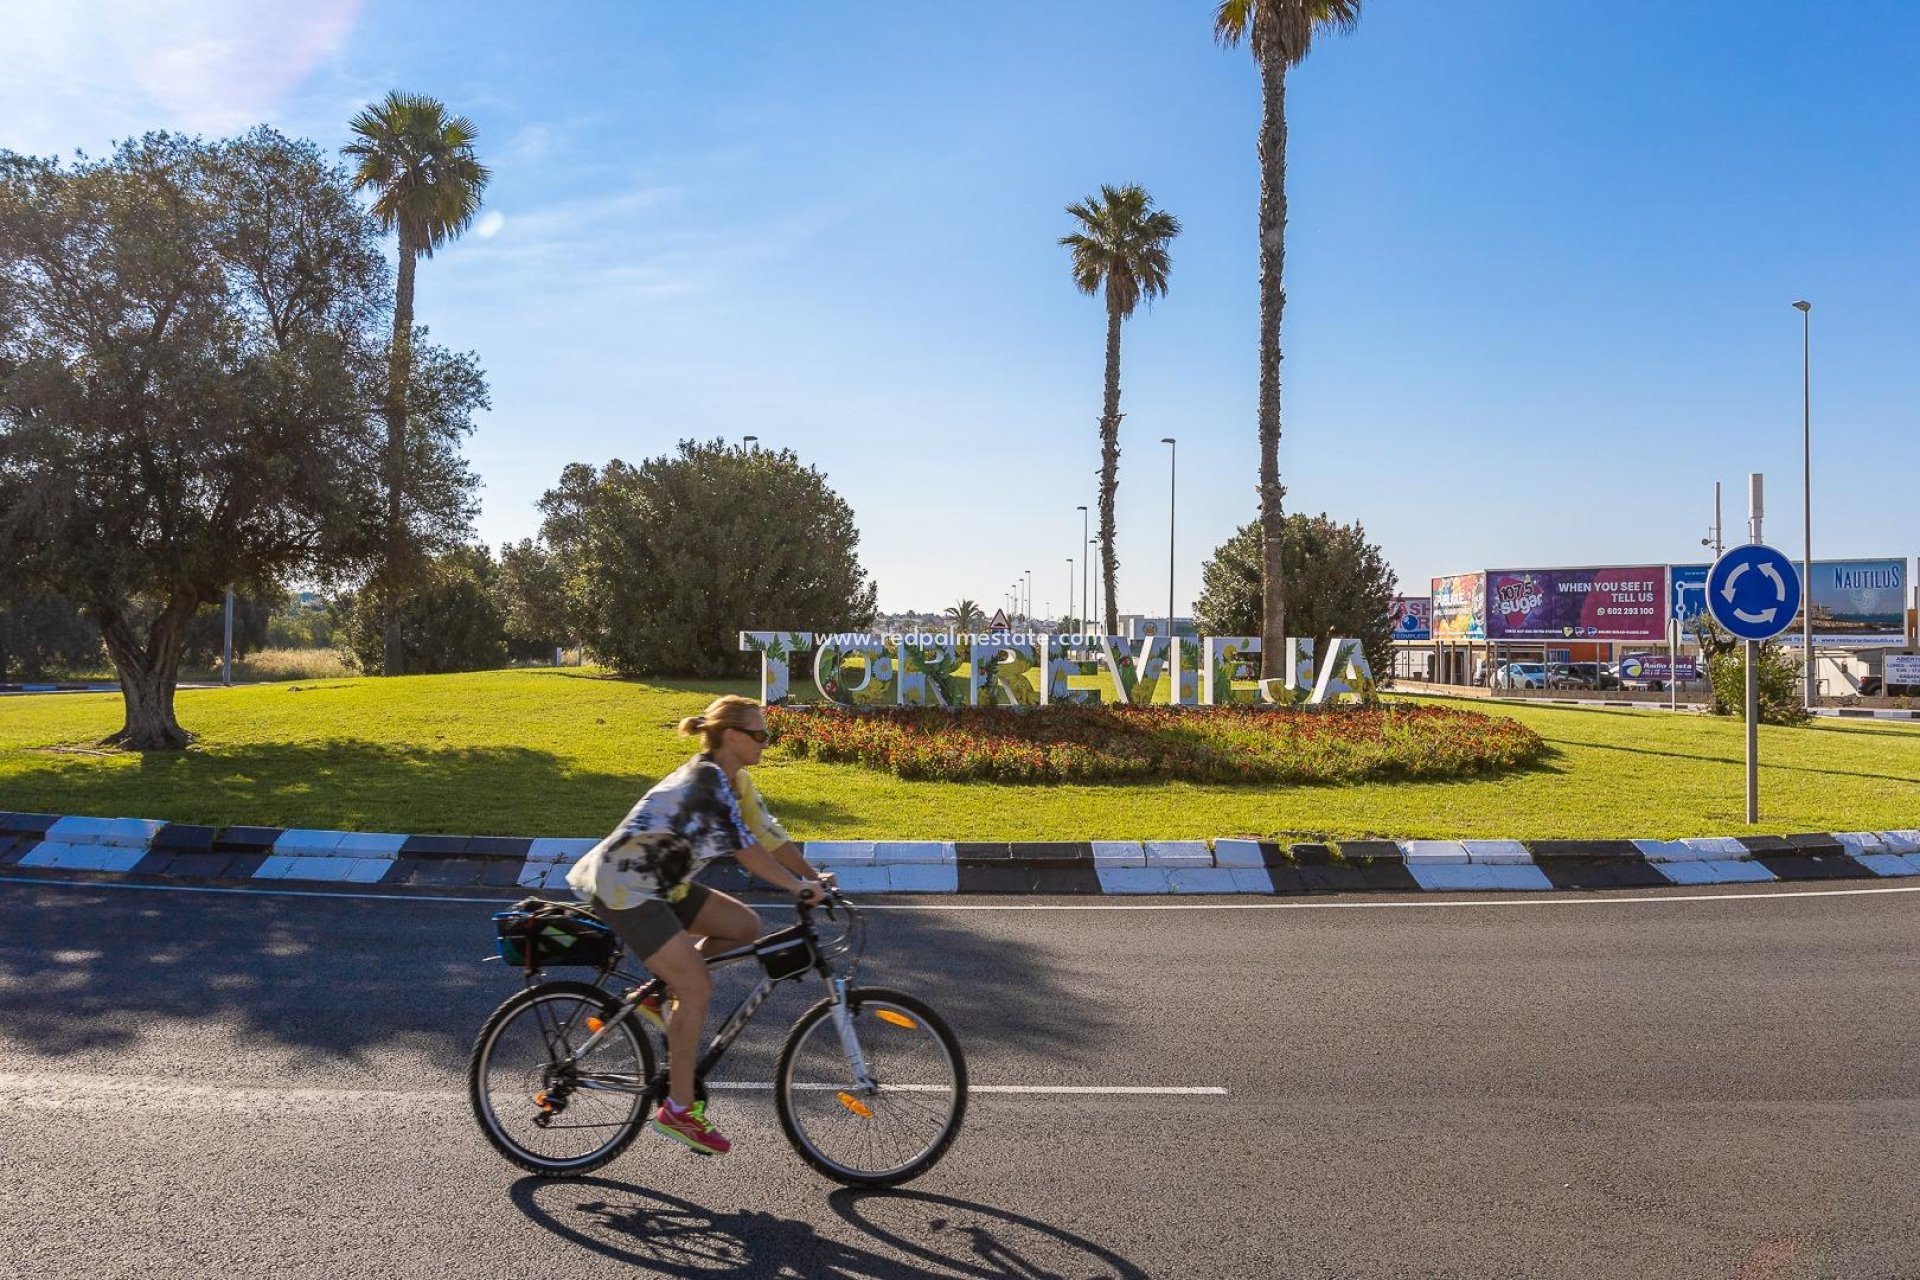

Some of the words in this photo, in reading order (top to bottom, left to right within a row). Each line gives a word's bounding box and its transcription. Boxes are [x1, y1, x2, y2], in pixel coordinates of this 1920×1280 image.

[1835, 565, 1900, 589] NAUTILUS
[1558, 582, 1591, 592] WHEN
[1594, 582, 1618, 592] YOU
[1620, 581, 1640, 591] SEE
[1643, 581, 1654, 591] IT
[1500, 593, 1543, 615] sugar
[1611, 593, 1636, 603] TELL
[1638, 593, 1654, 603] US
[1640, 607, 1654, 615] 100
[739, 631, 1377, 706] TORREVIEJA
